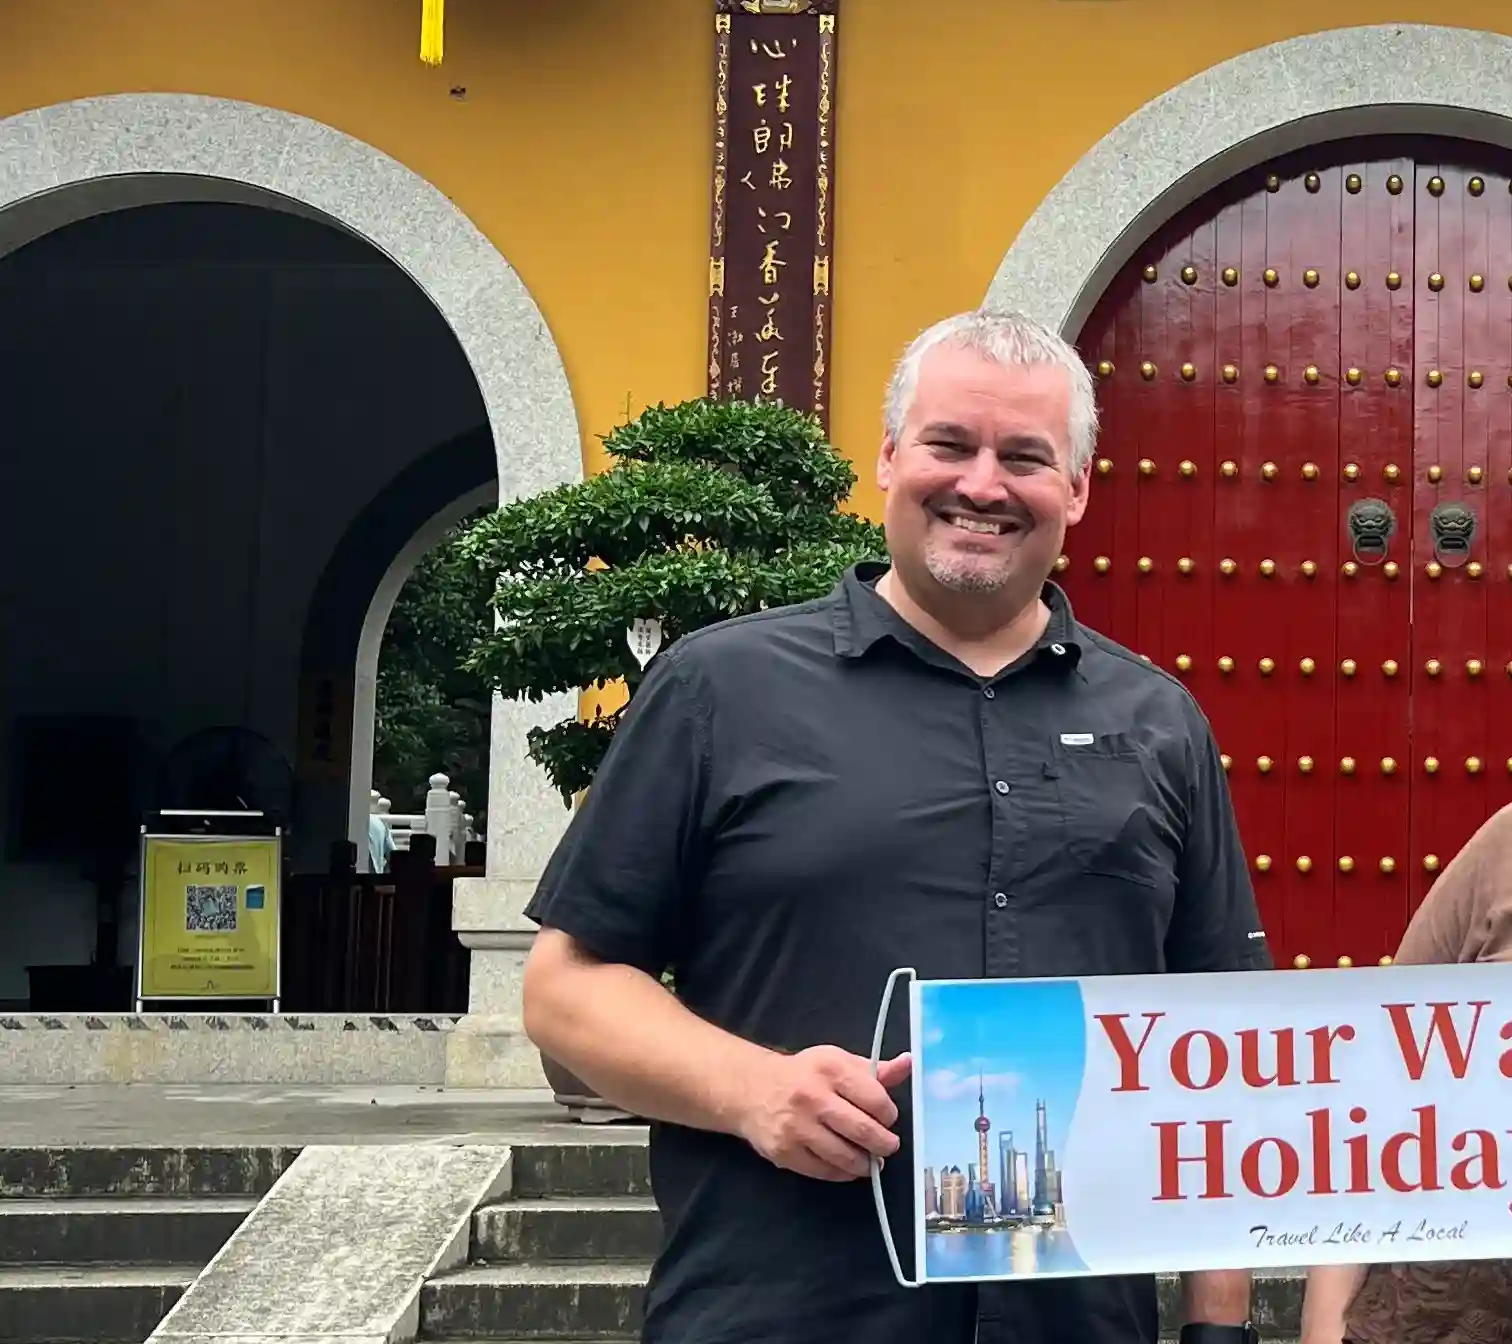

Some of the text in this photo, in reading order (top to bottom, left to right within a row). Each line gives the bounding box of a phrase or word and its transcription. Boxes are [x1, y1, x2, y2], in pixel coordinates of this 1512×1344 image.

[1093, 1012, 1356, 1092] Your
[1249, 1218, 1469, 1248] Travel Like A Local
